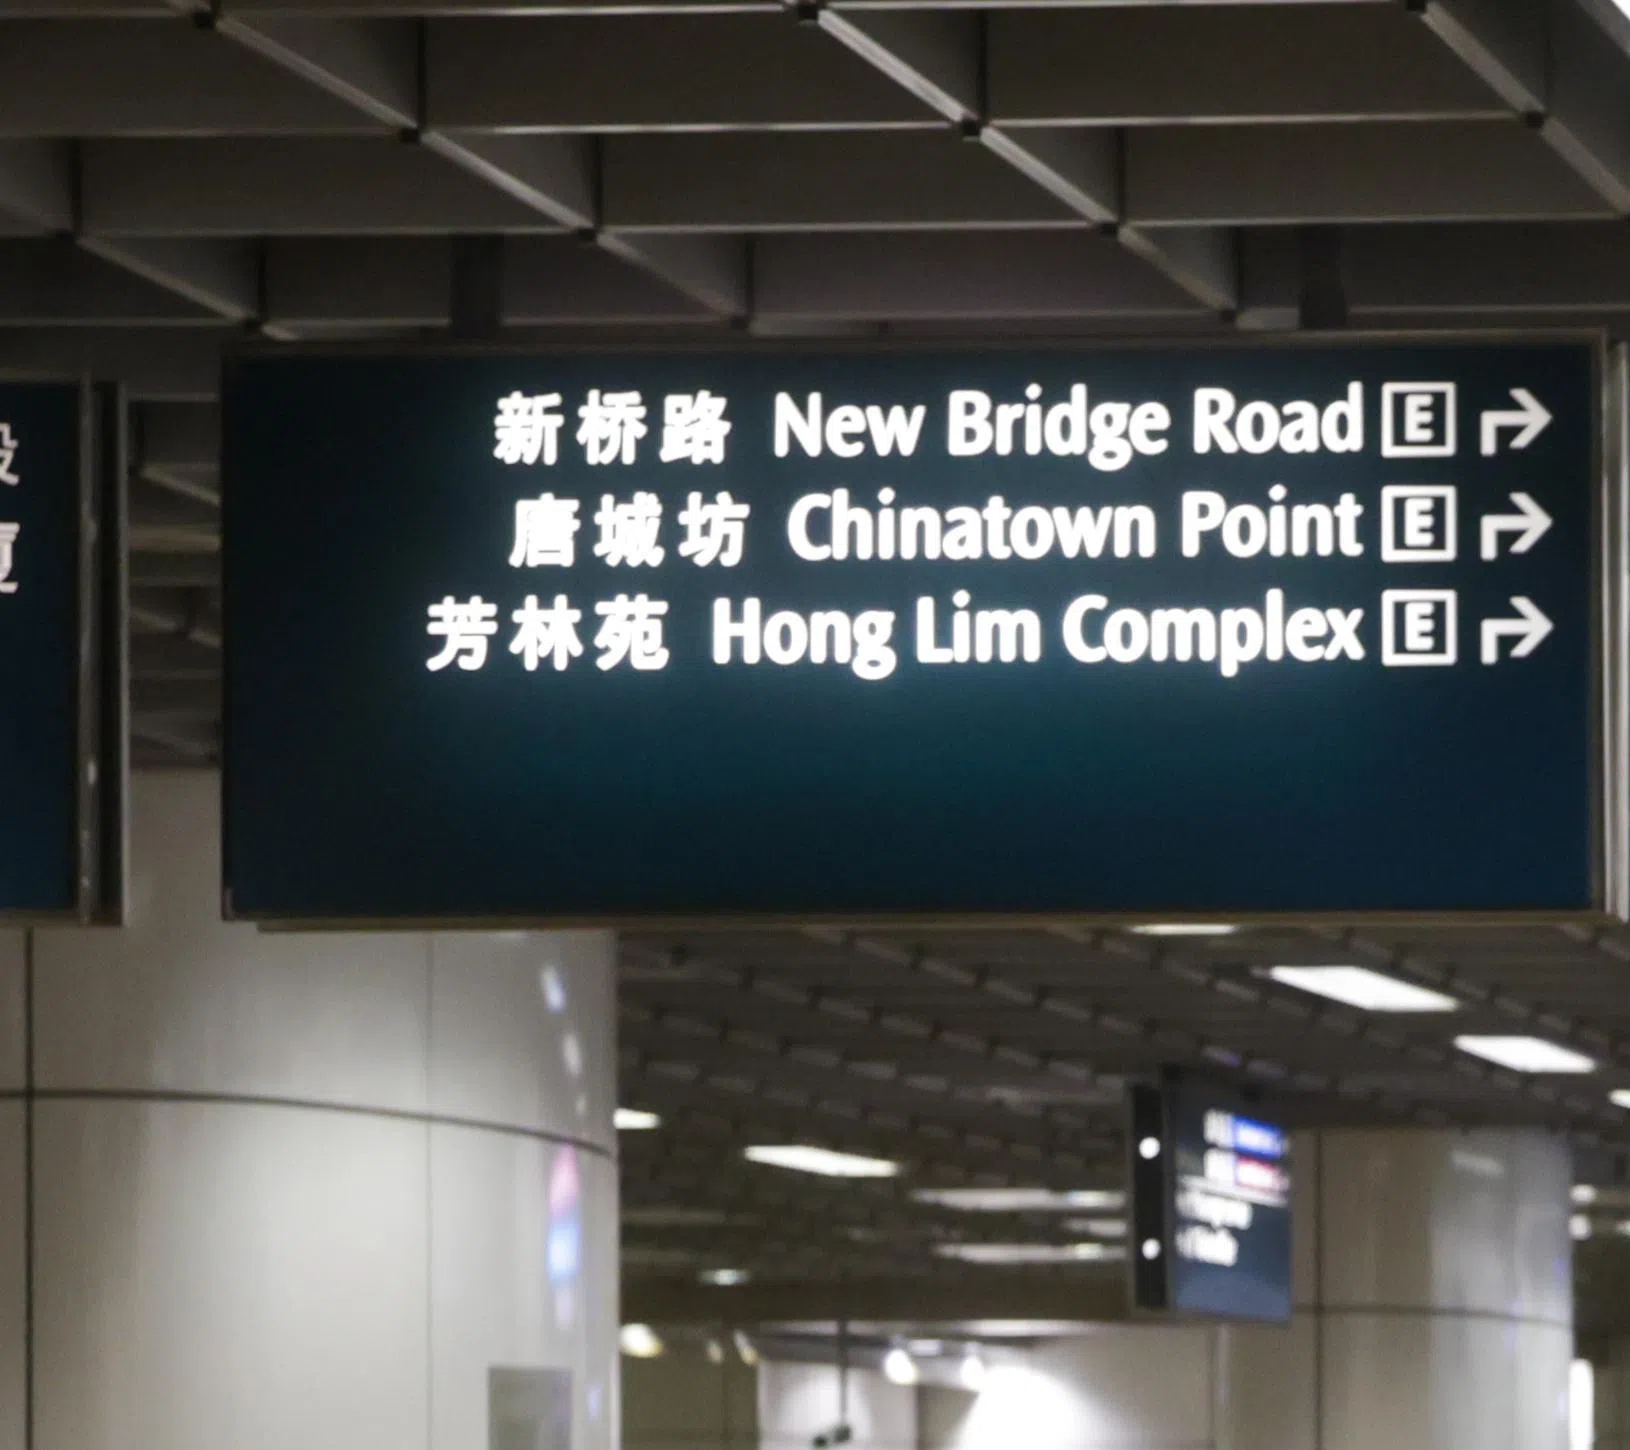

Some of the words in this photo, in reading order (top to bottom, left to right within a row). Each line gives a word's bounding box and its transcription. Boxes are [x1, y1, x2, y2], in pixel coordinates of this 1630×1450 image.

[493, 389, 732, 465] 新桥路
[774, 391, 926, 458] New
[947, 383, 1172, 471] Bridge
[1193, 380, 1364, 454] Road
[509, 491, 750, 567] 唐城坊
[787, 486, 1156, 560] Chinatown
[1181, 483, 1364, 558] Point
[426, 594, 669, 671] 芳林苑
[713, 597, 897, 680] Hong
[917, 590, 1041, 663] Lim
[1063, 588, 1365, 678] Complex
